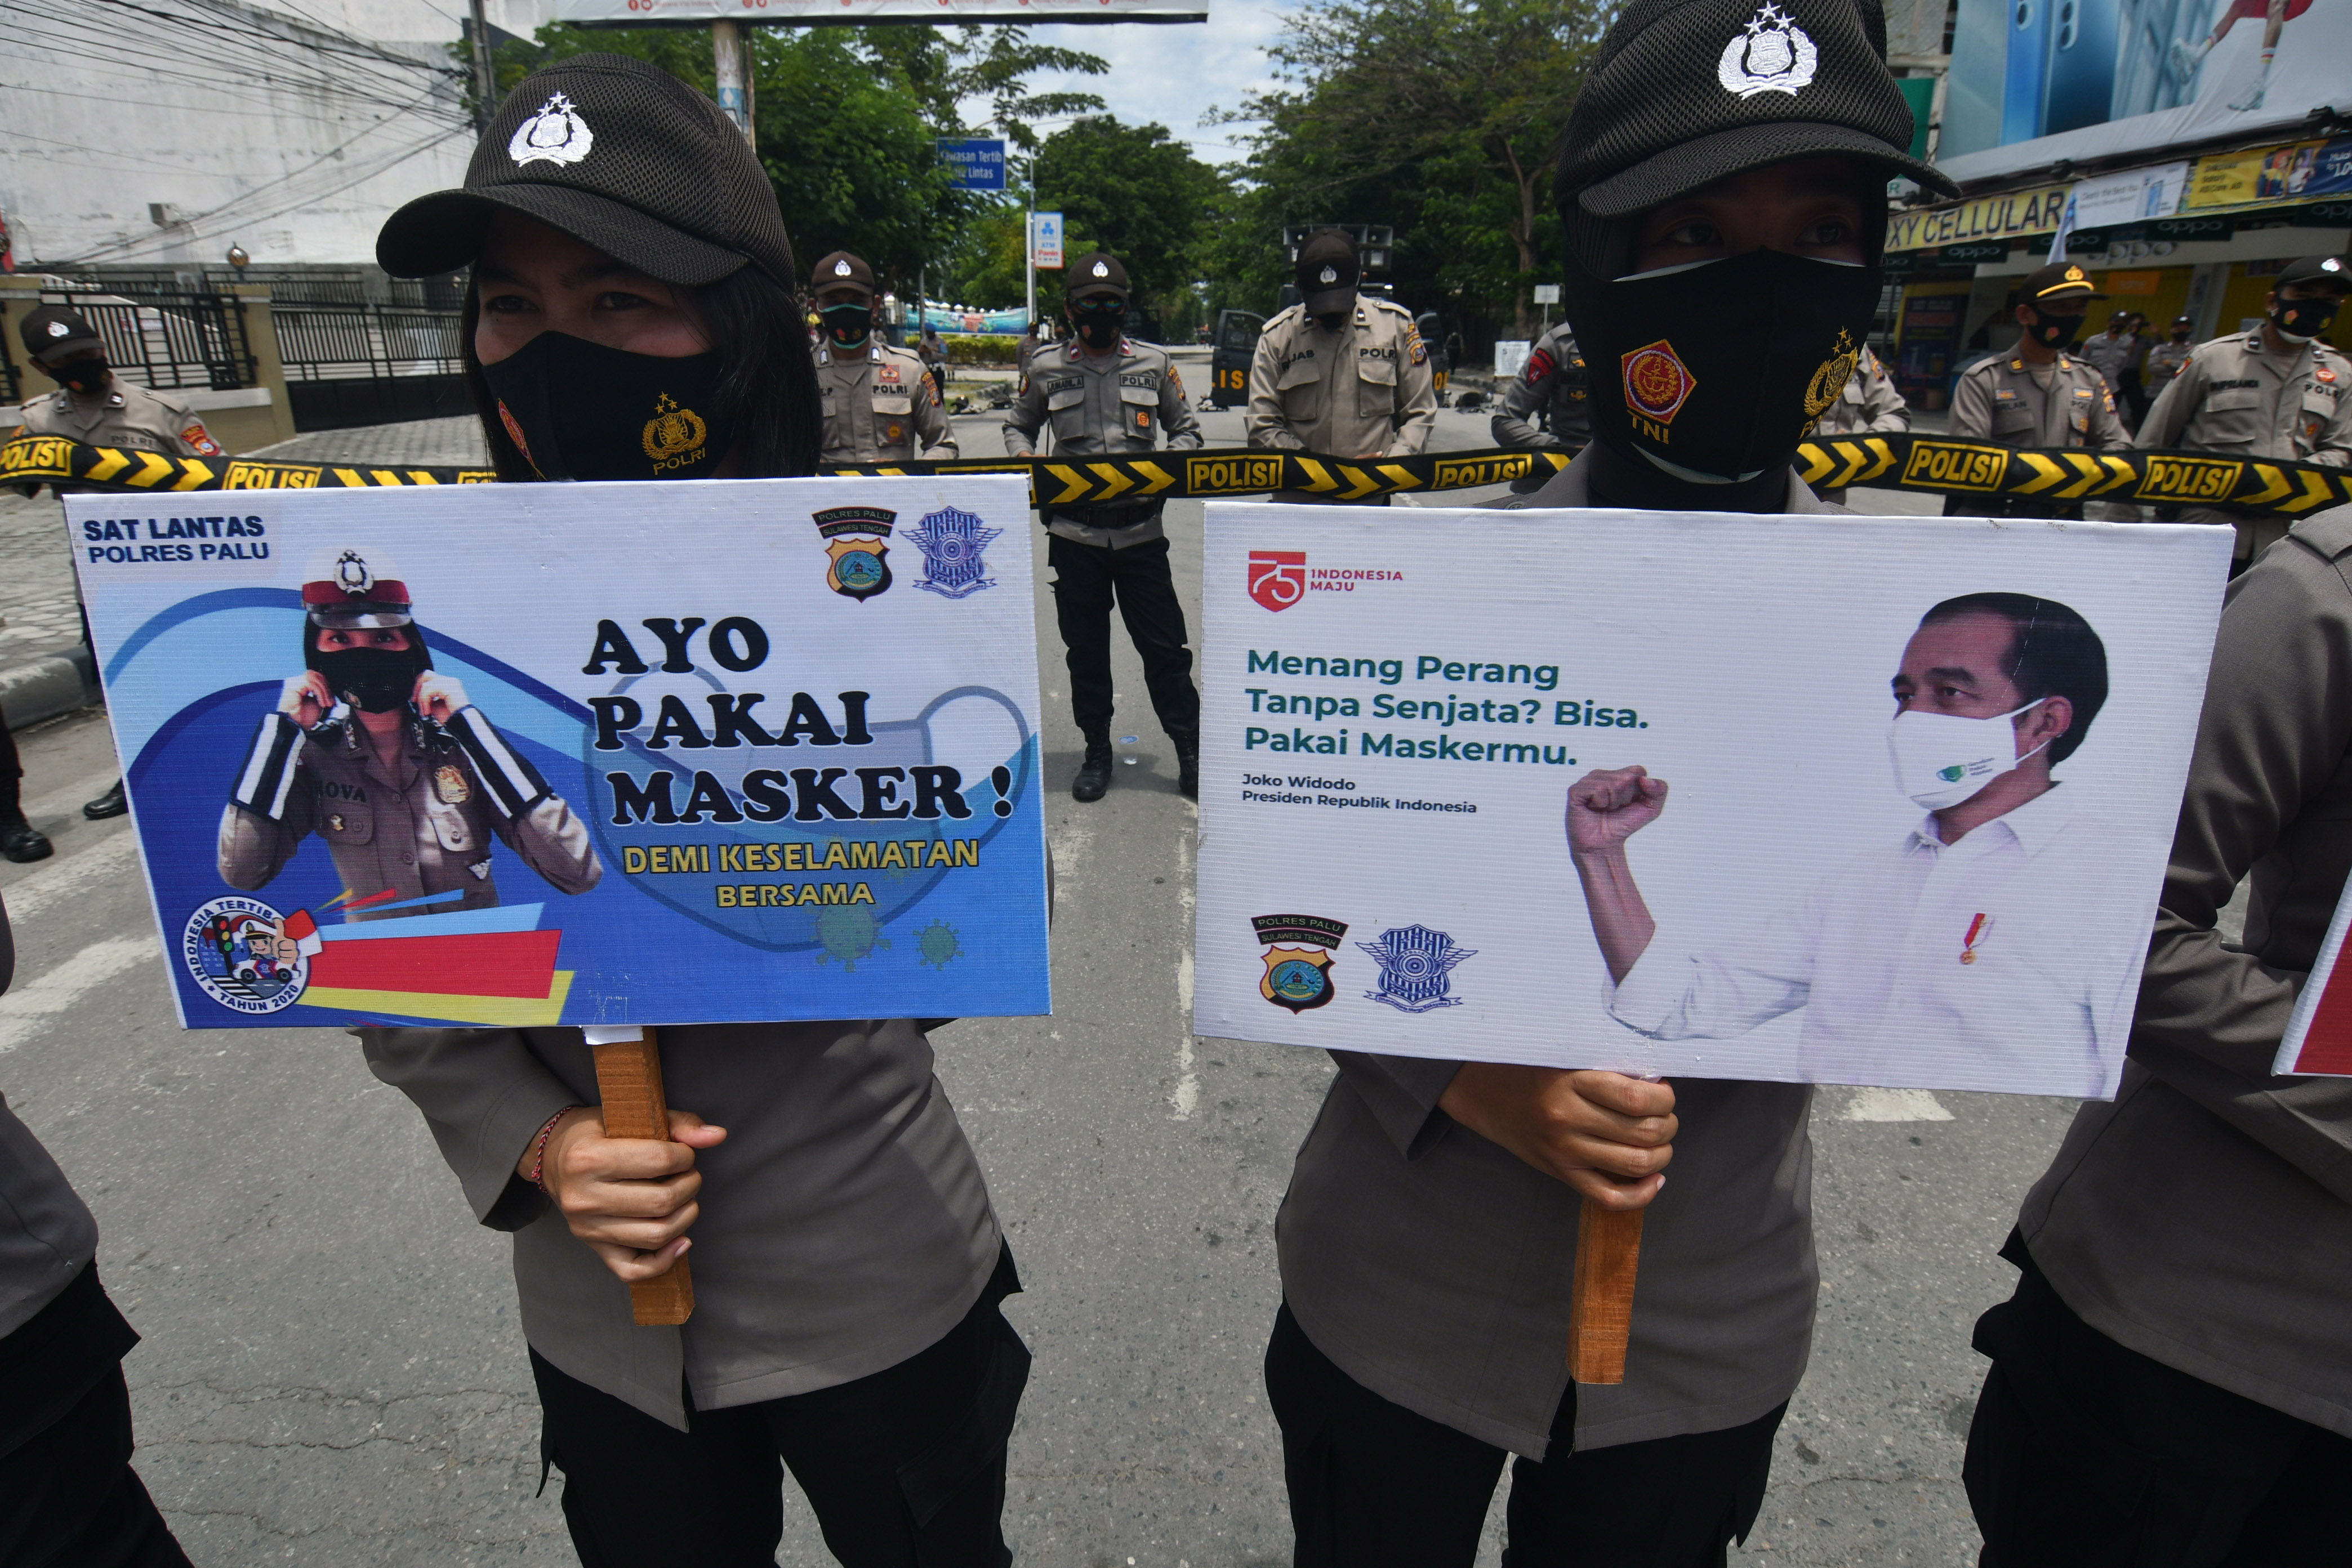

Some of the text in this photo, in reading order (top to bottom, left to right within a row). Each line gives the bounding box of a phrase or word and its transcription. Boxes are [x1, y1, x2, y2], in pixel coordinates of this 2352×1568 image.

[978, 150, 1003, 163] Tertib
[968, 166, 994, 179] Lintas
[1887, 191, 2066, 248] XY CELLULAR
[873, 385, 908, 394] POLRI
[1122, 376, 1155, 387] POLRI
[1627, 409, 1669, 445] TNI
[110, 435, 154, 446] POLRI
[653, 447, 706, 475] POLRI
[1439, 460, 1525, 487] POLISI
[1909, 448, 2001, 484] POLISI
[1194, 461, 1277, 489] POLISI
[2144, 463, 2235, 497] POLISI
[84, 515, 265, 541] SAT LANTAS
[818, 510, 891, 522] POLRES PALU
[823, 524, 889, 536] SULAWESI TENGAH
[88, 542, 270, 563] POLRES PALU
[1310, 581, 1355, 591] MAJU
[1311, 568, 1404, 581] INDONESIA
[582, 616, 770, 675] AYO
[1247, 649, 1559, 691] Menang Perang
[587, 691, 874, 750] PAKAI
[1245, 688, 1649, 729] Tanpa Senjata? Bisa.
[1245, 725, 1578, 766] Pakai Maskermu.
[1242, 773, 1356, 791] Joko Widodo
[605, 765, 1013, 826] MASKER !
[1242, 790, 1477, 814] Presiden Republik Indonesia
[622, 839, 980, 875] DEMI KESELAMATAN
[715, 882, 877, 908] BERSAMA
[1258, 917, 1341, 932] POLRES PALU
[186, 900, 273, 982] INDONESIA TERTIB
[1260, 933, 1337, 947] SULAWESI TENGAH
[220, 984, 299, 1011] TAHUN 2020
